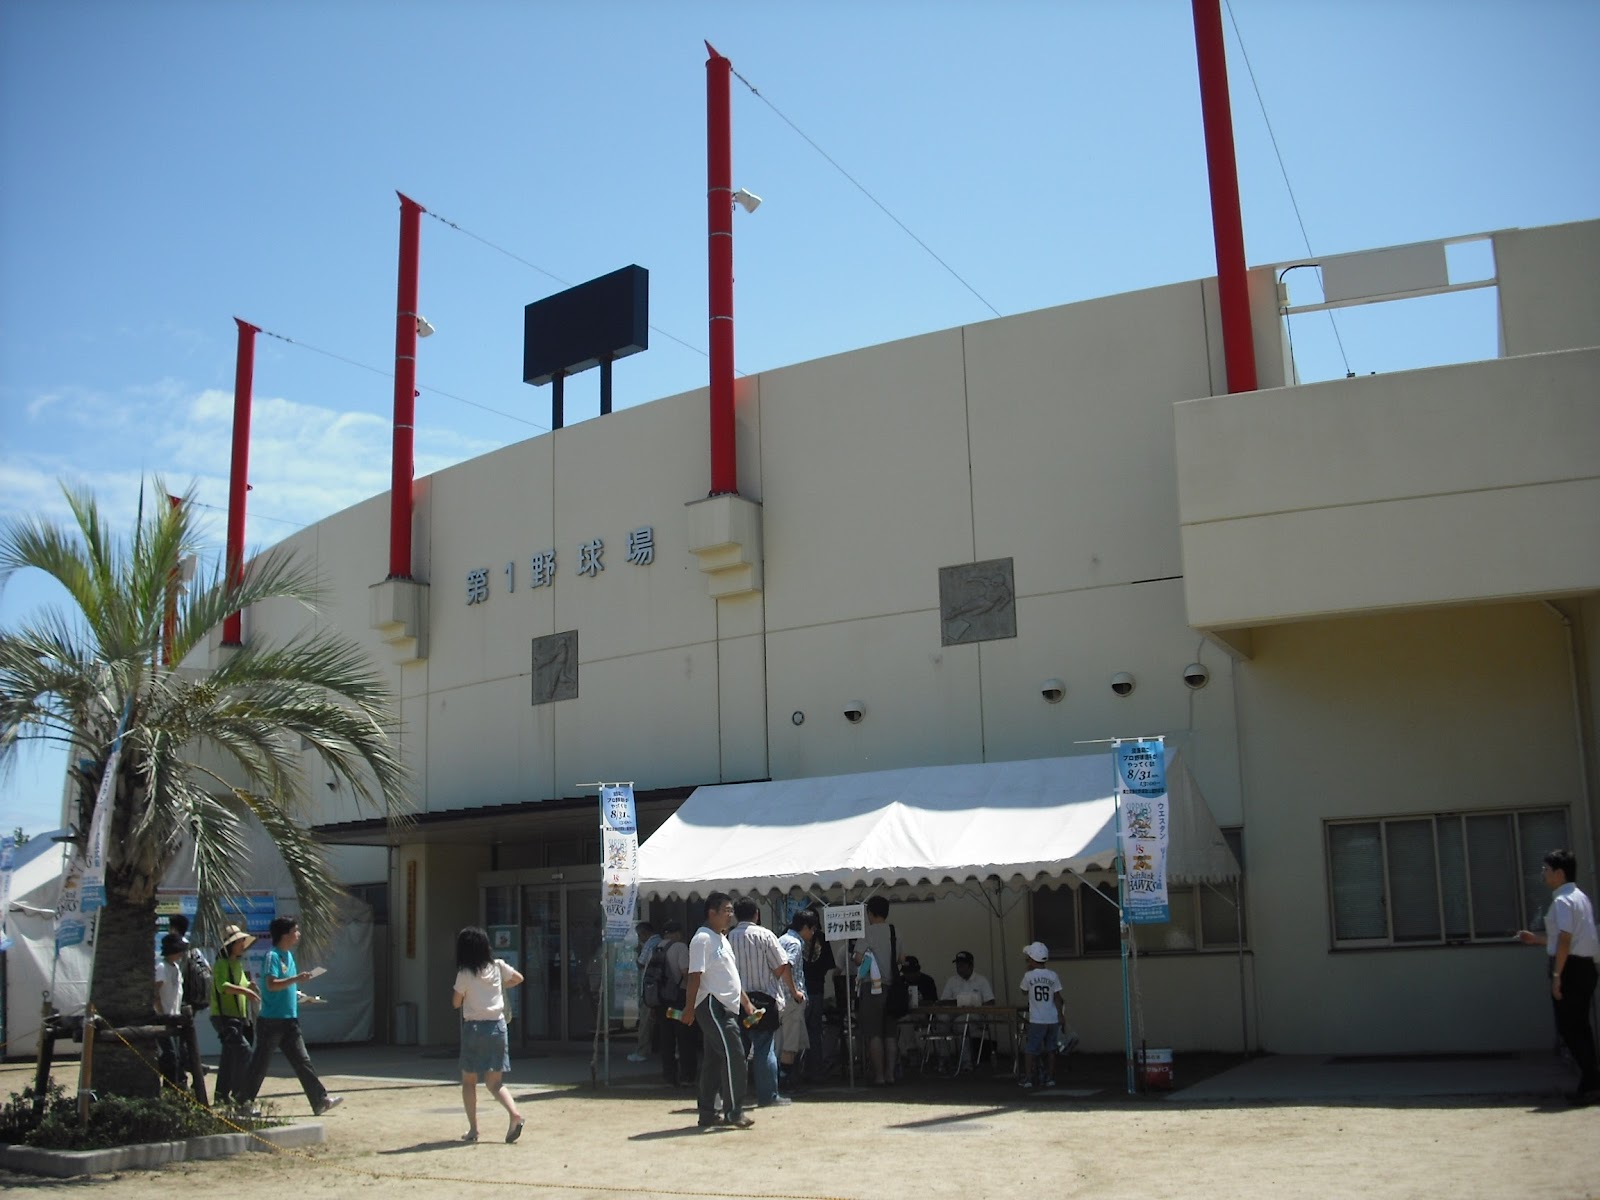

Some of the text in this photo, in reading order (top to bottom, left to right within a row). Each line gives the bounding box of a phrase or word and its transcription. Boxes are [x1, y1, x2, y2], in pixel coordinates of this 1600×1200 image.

[466, 527, 655, 606] 第1野球場
[1127, 769, 1151, 781] 8/31
[827, 920, 862, 933] チケット販売
[1034, 985, 1050, 1002] 66
